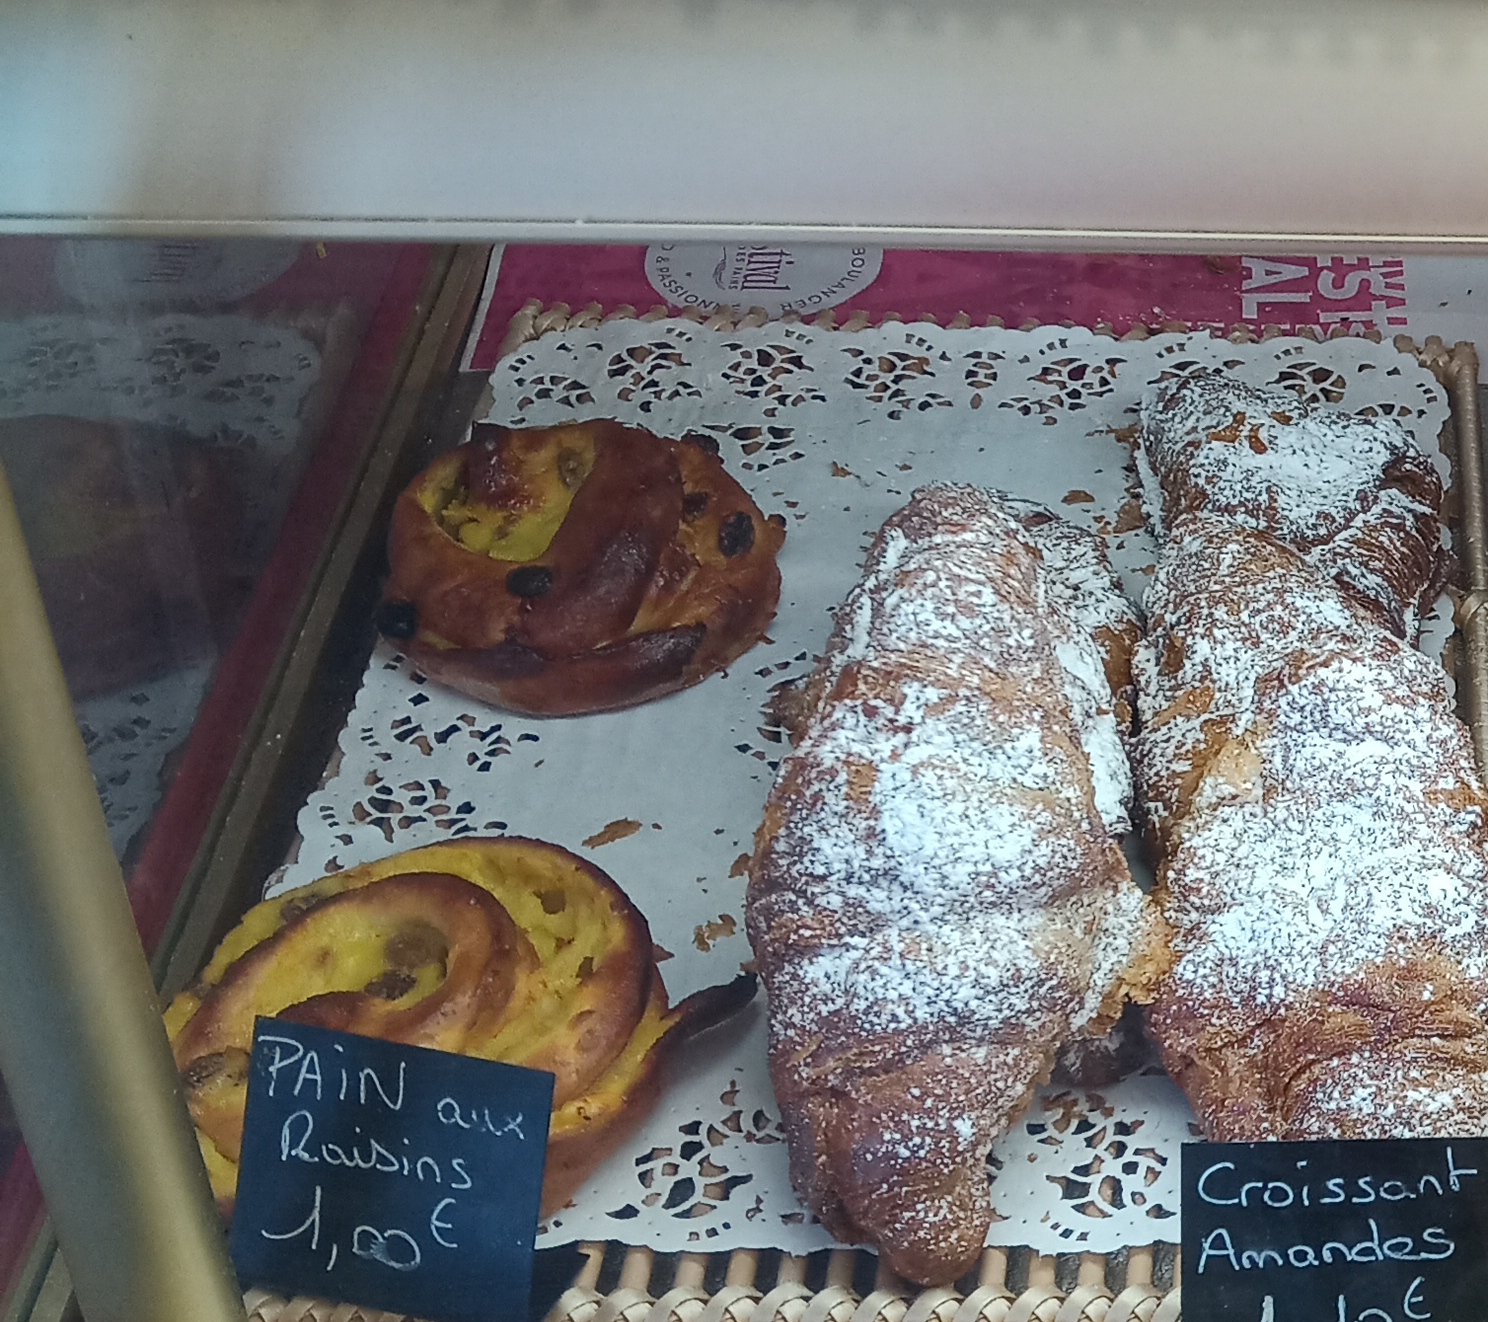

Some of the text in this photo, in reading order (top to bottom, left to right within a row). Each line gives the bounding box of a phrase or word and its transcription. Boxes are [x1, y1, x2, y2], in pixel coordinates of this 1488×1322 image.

[436, 1097, 525, 1140] aux
[281, 1109, 472, 1189] Raisins
[1198, 1146, 1478, 1208] Croissant
[1197, 1218, 1456, 1275] Amandes
